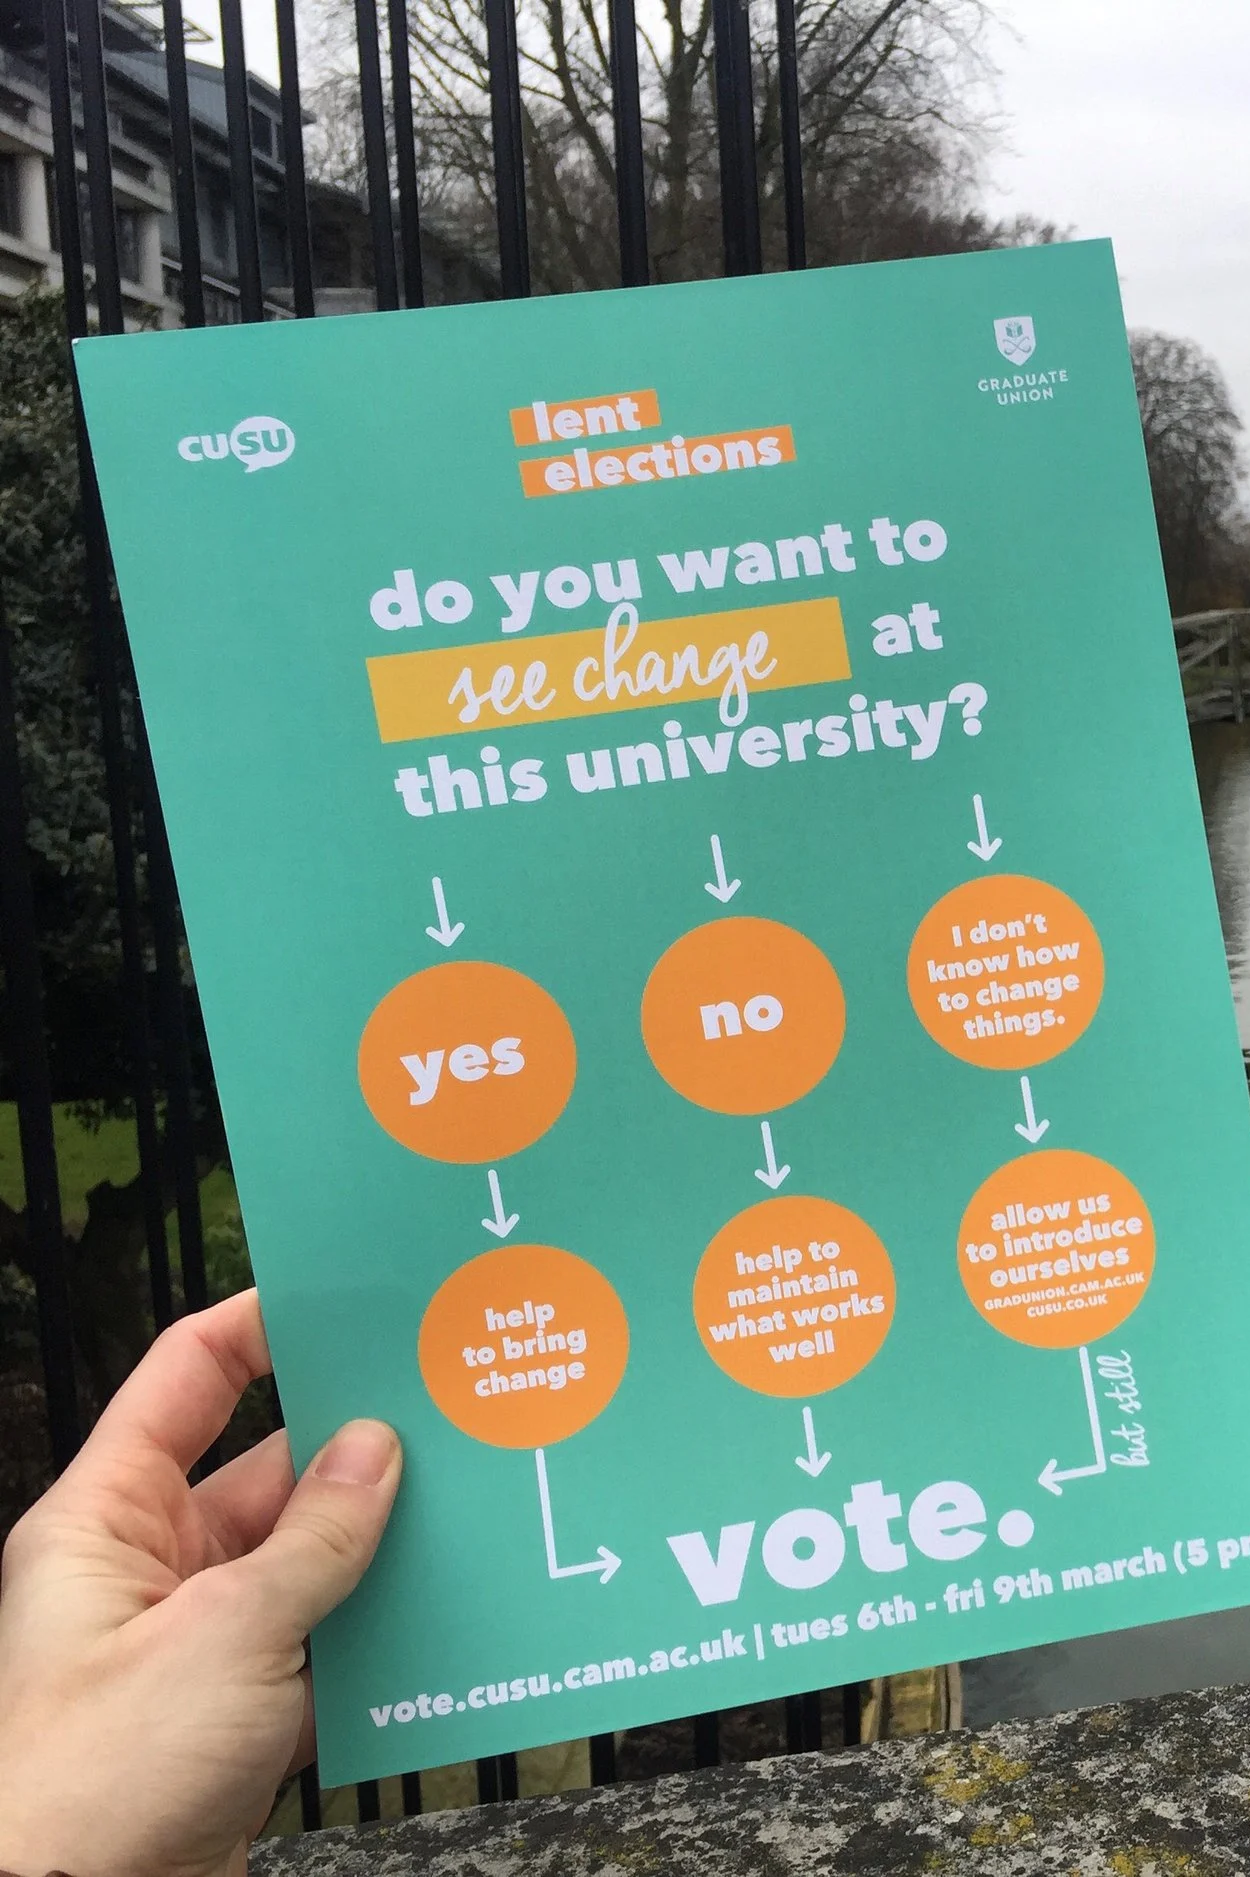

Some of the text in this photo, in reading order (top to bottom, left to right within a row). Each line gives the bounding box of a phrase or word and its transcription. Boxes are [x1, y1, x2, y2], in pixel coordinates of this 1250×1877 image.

[978, 370, 1069, 392] GRADUATE
[998, 388, 1054, 405] UNION
[533, 397, 641, 441] lent
[179, 426, 290, 463] CUSU
[544, 434, 783, 494] elections
[369, 516, 948, 634] do you want to
[448, 601, 944, 728] see change at
[394, 682, 988, 818] this university?
[952, 913, 1047, 947] I don't
[927, 943, 1080, 982] know how
[937, 974, 1079, 1012] to change
[700, 994, 784, 1040] no
[963, 1009, 1065, 1040] things.
[400, 1037, 525, 1106] yes
[991, 1194, 1110, 1231] allow us
[735, 1241, 841, 1275] help to
[965, 1217, 1143, 1263] to introduce
[727, 1265, 859, 1308] maintain
[991, 1247, 1129, 1288] ourselves
[984, 1272, 1145, 1311] GRADUNION.CAM.AC.UK
[1027, 1294, 1107, 1317] CUSU.CO.UK
[486, 1301, 556, 1332] help
[709, 1293, 885, 1342] what works
[462, 1327, 588, 1367] to bring
[769, 1329, 835, 1363] well
[475, 1361, 585, 1397] change
[1095, 1350, 1151, 1467] but still
[667, 1480, 1035, 1607] vote.
[370, 1629, 748, 1728] vote.cusu.cam.ac.uk
[770, 1614, 849, 1648] tues
[856, 1594, 917, 1632] 6th
[942, 1578, 986, 1614] fri
[992, 1568, 1054, 1604] 9th
[1060, 1546, 1167, 1591] march
[1172, 1537, 1209, 1575] (5
